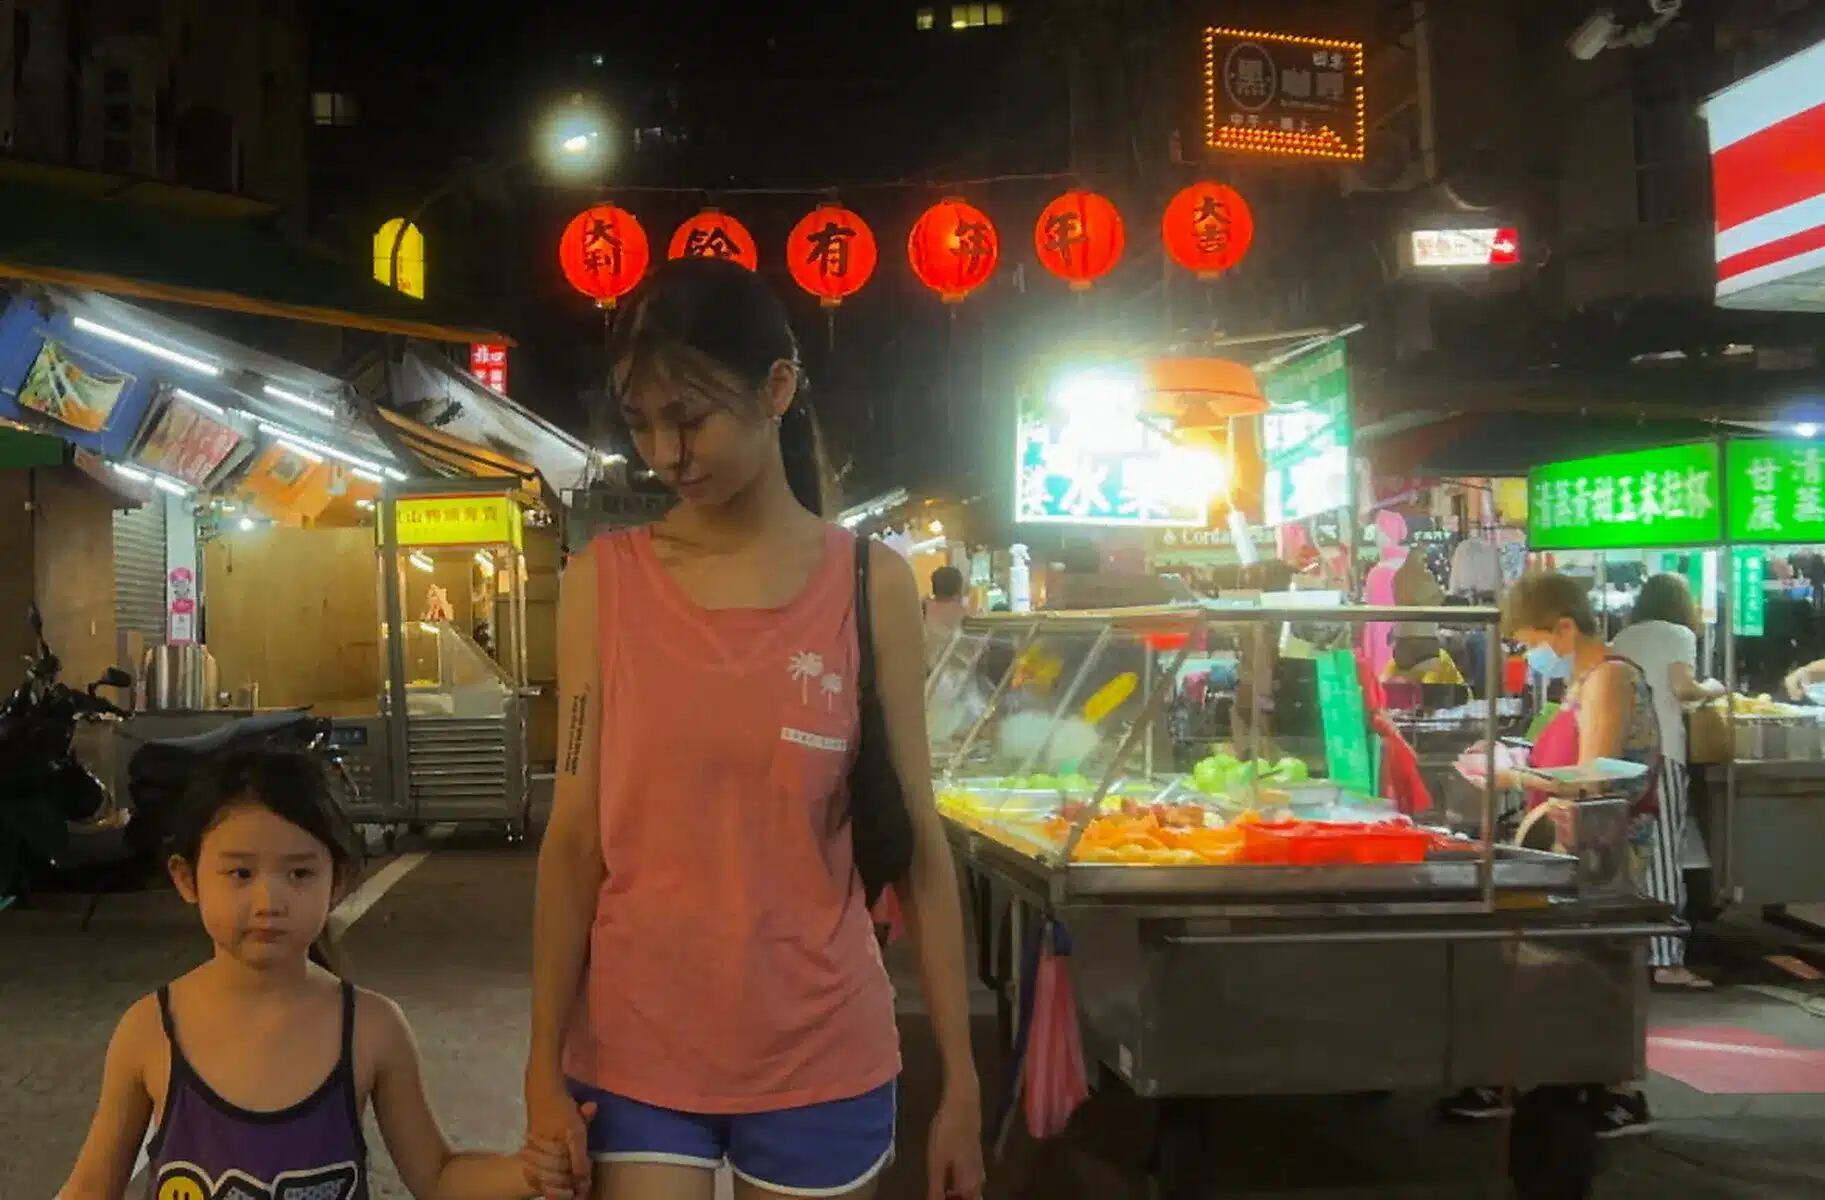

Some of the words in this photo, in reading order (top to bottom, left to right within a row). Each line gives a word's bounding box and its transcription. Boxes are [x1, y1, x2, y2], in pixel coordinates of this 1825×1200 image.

[584, 218, 622, 276] 大利
[807, 221, 858, 278] 有
[1044, 210, 1088, 267] 年
[1193, 195, 1232, 254] 大吉
